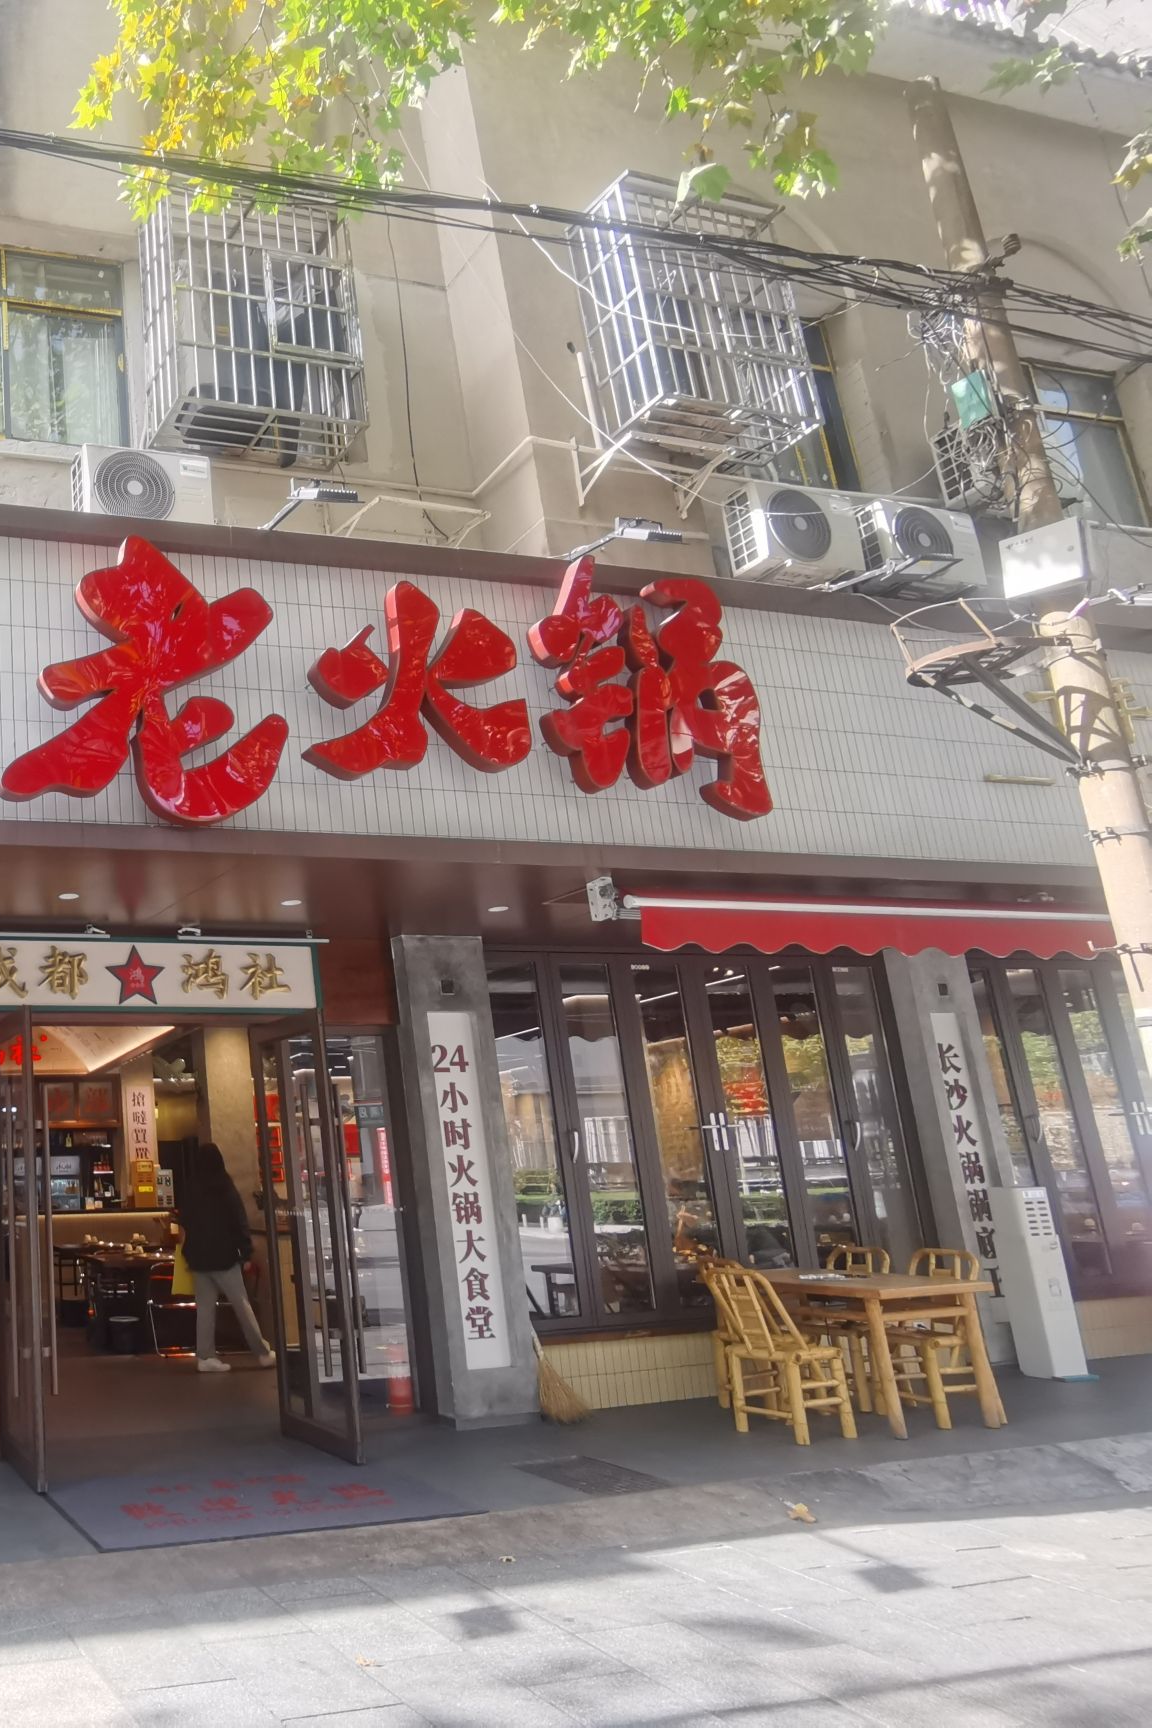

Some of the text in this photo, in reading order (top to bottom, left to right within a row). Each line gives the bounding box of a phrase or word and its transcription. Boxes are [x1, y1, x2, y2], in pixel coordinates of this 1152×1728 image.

[180, 948, 291, 999] 鸿社
[431, 1044, 496, 1341] 24小时火锅大食堂
